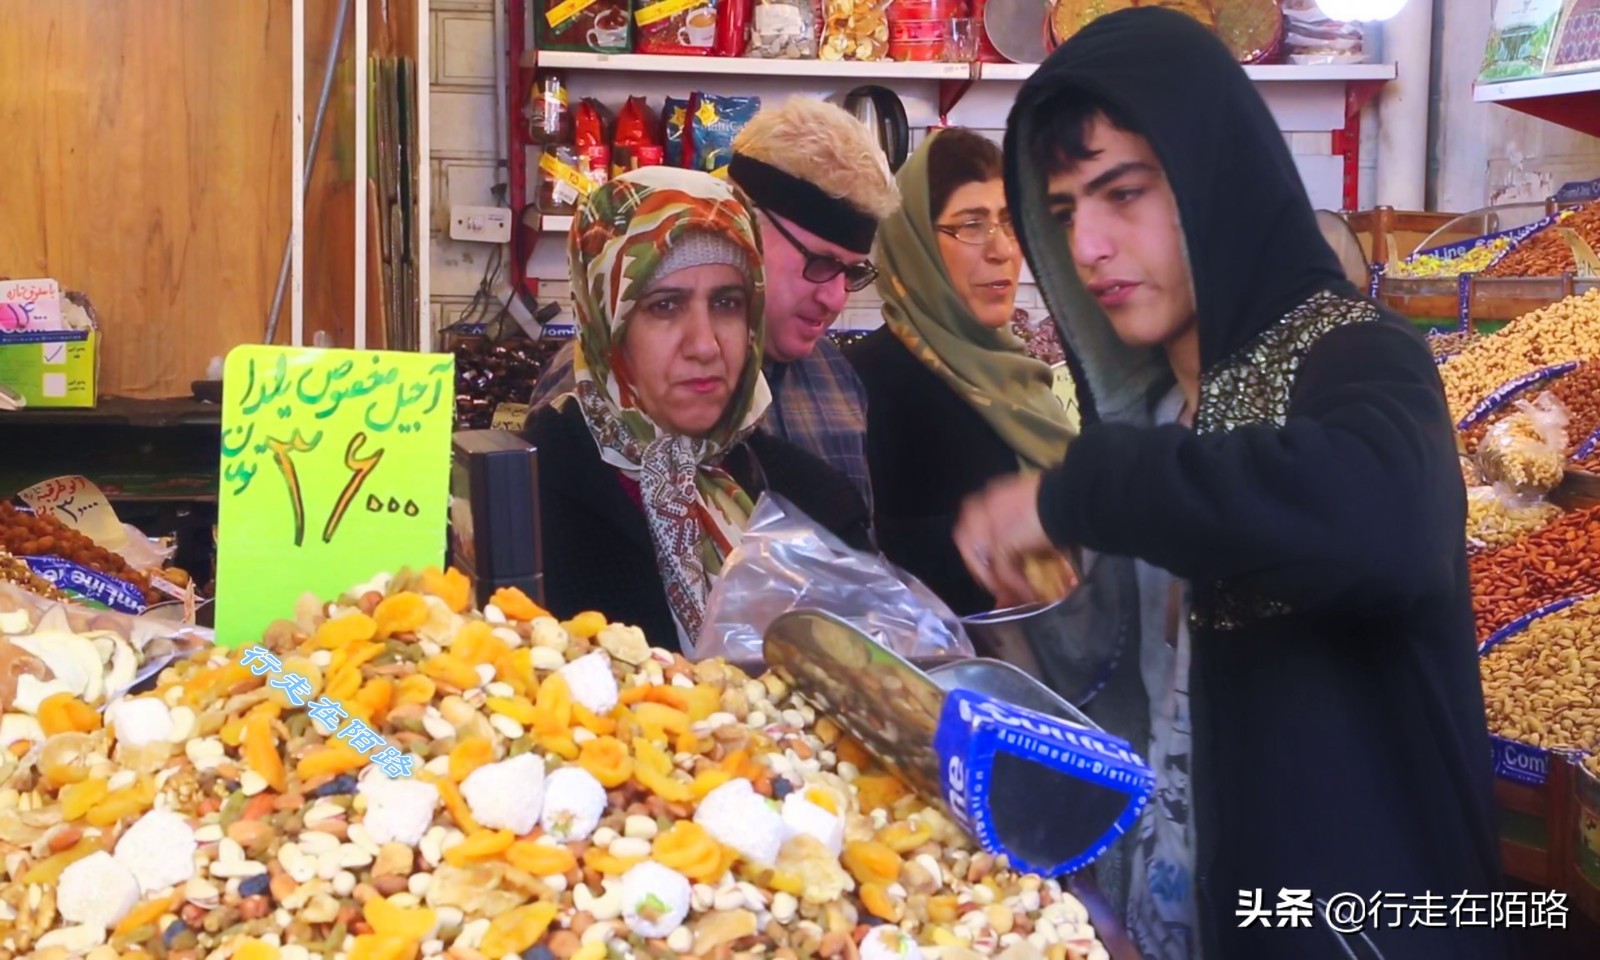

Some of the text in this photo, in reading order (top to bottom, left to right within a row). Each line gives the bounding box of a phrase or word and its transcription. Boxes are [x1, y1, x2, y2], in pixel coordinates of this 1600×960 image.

[239, 353, 454, 432] آجیل مخصوص یلدا
